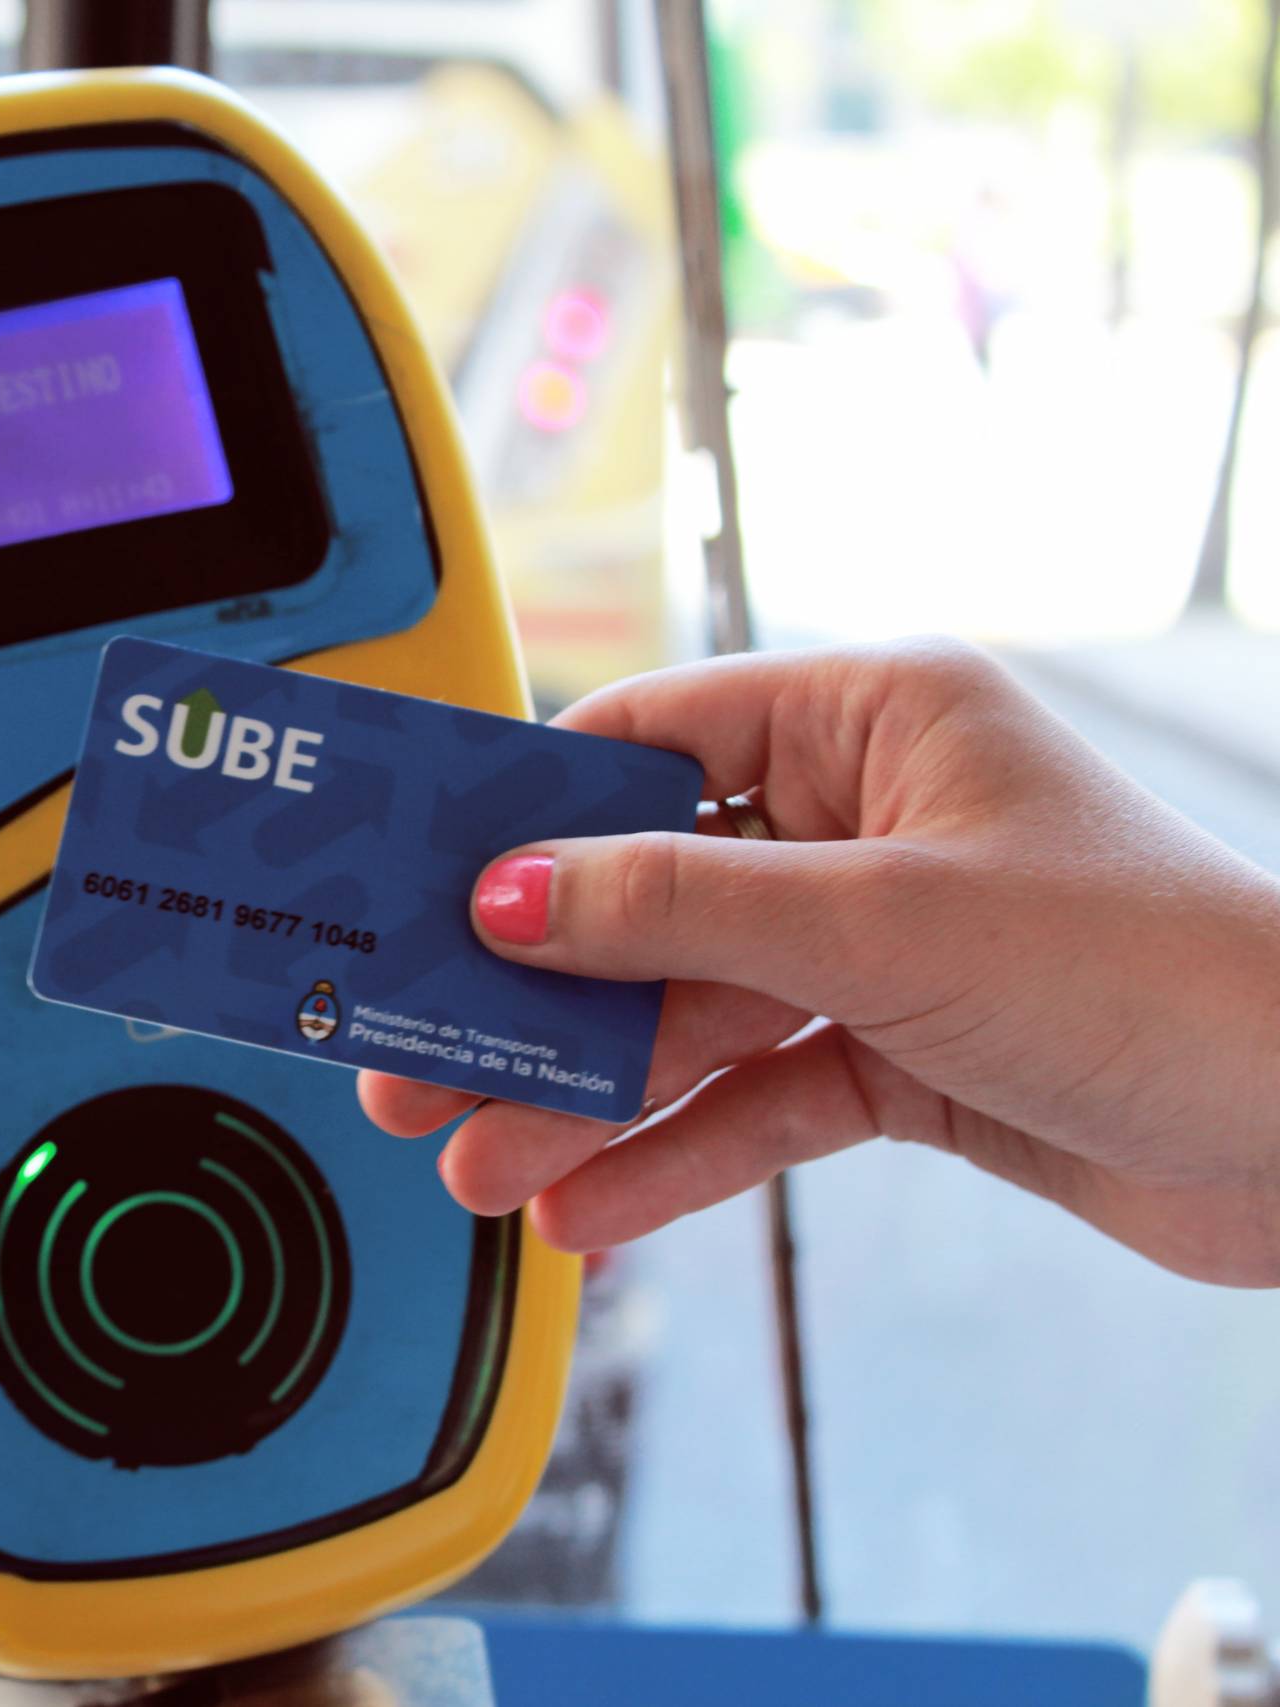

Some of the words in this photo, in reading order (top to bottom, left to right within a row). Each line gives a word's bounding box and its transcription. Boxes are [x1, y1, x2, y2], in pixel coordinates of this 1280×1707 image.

[116, 694, 325, 794] SUBE
[83, 872, 149, 905] 6061
[157, 888, 225, 921] 2681
[234, 904, 304, 938] 9677
[311, 921, 377, 954] 1048
[348, 1022, 474, 1064] Presidencia
[479, 1051, 508, 1071] de
[513, 1057, 532, 1077] la
[537, 1063, 616, 1095] Nación
[352, 1005, 435, 1035] Ministerio
[438, 1023, 462, 1040] de
[465, 1028, 558, 1061] Transporte
